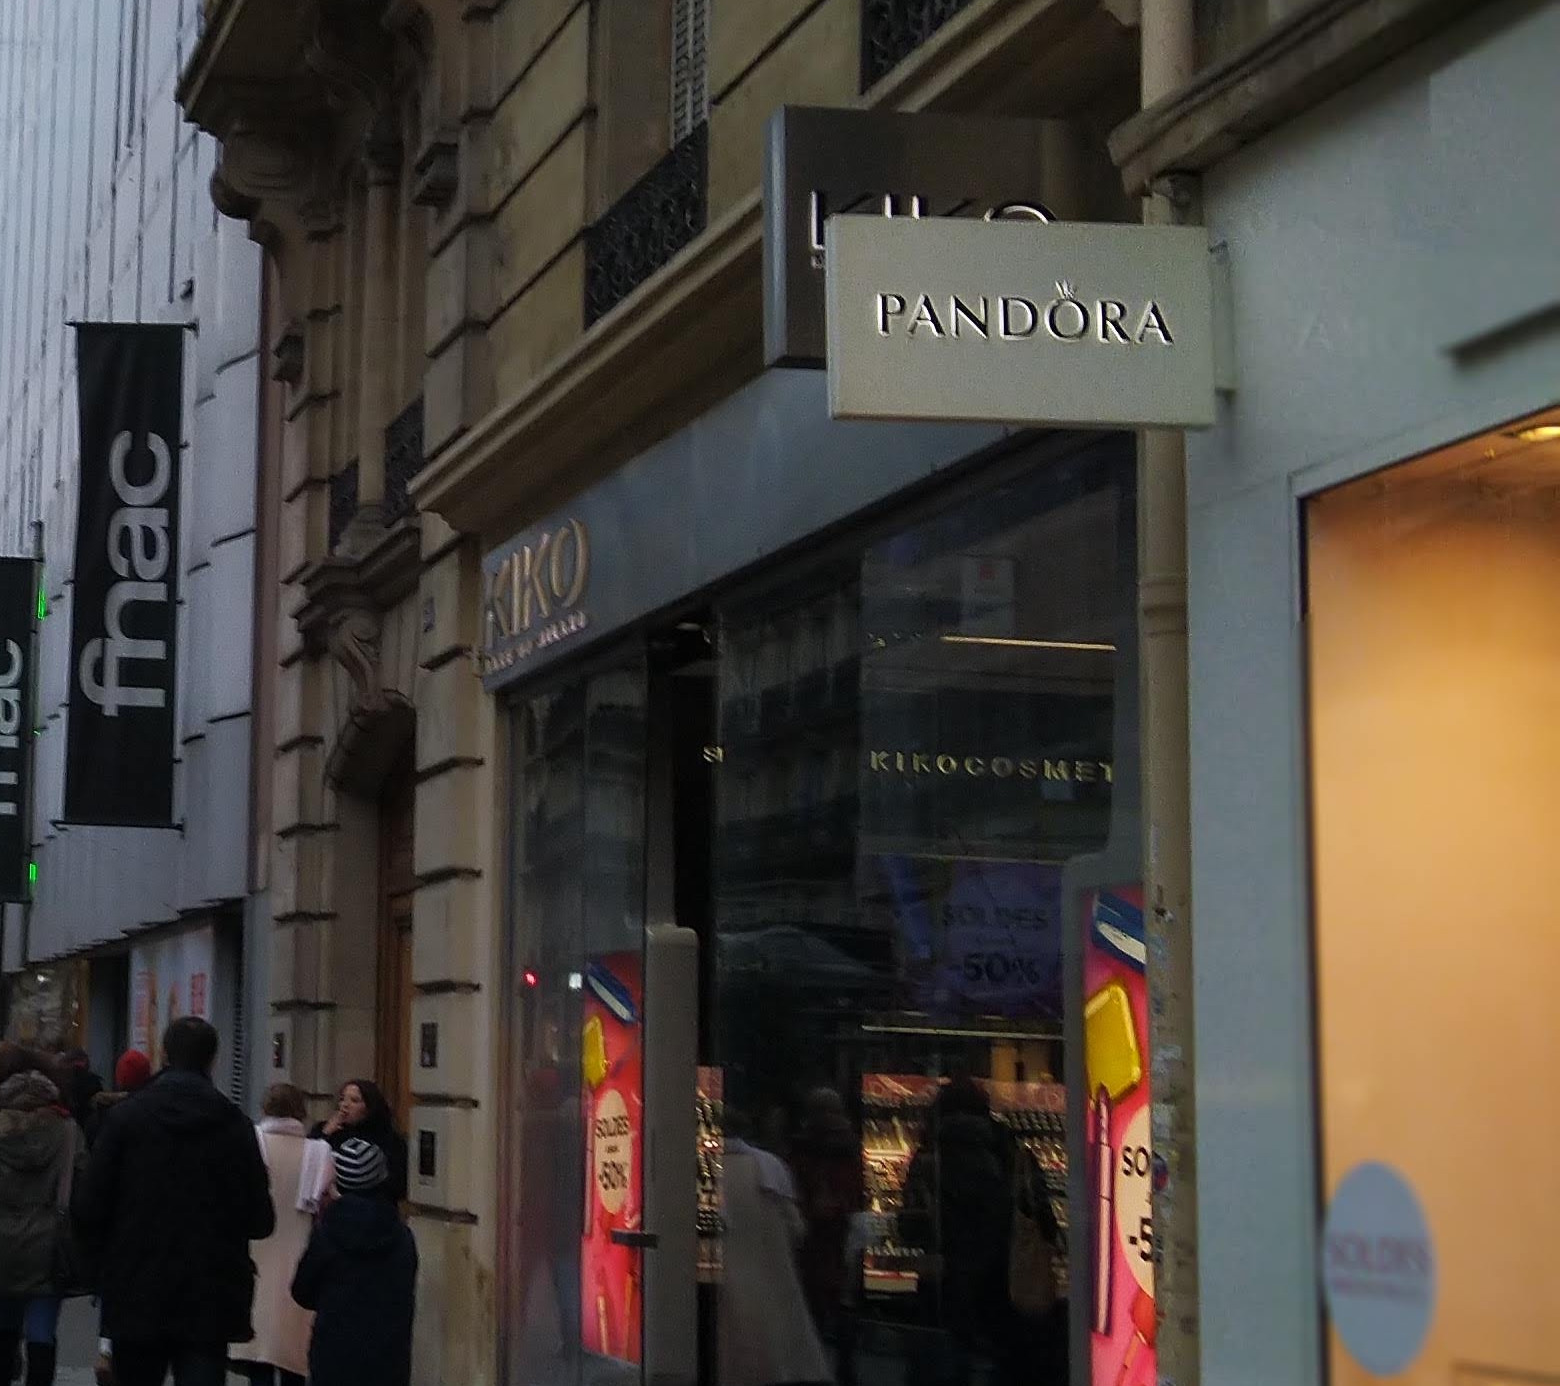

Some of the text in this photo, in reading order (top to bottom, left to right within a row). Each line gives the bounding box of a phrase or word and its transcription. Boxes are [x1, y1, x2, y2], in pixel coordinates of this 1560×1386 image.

[876, 287, 1175, 346] PANDORA
[78, 429, 173, 718] fnac
[484, 517, 590, 647] KIKO
[595, 1115, 630, 1139] SOLDES
